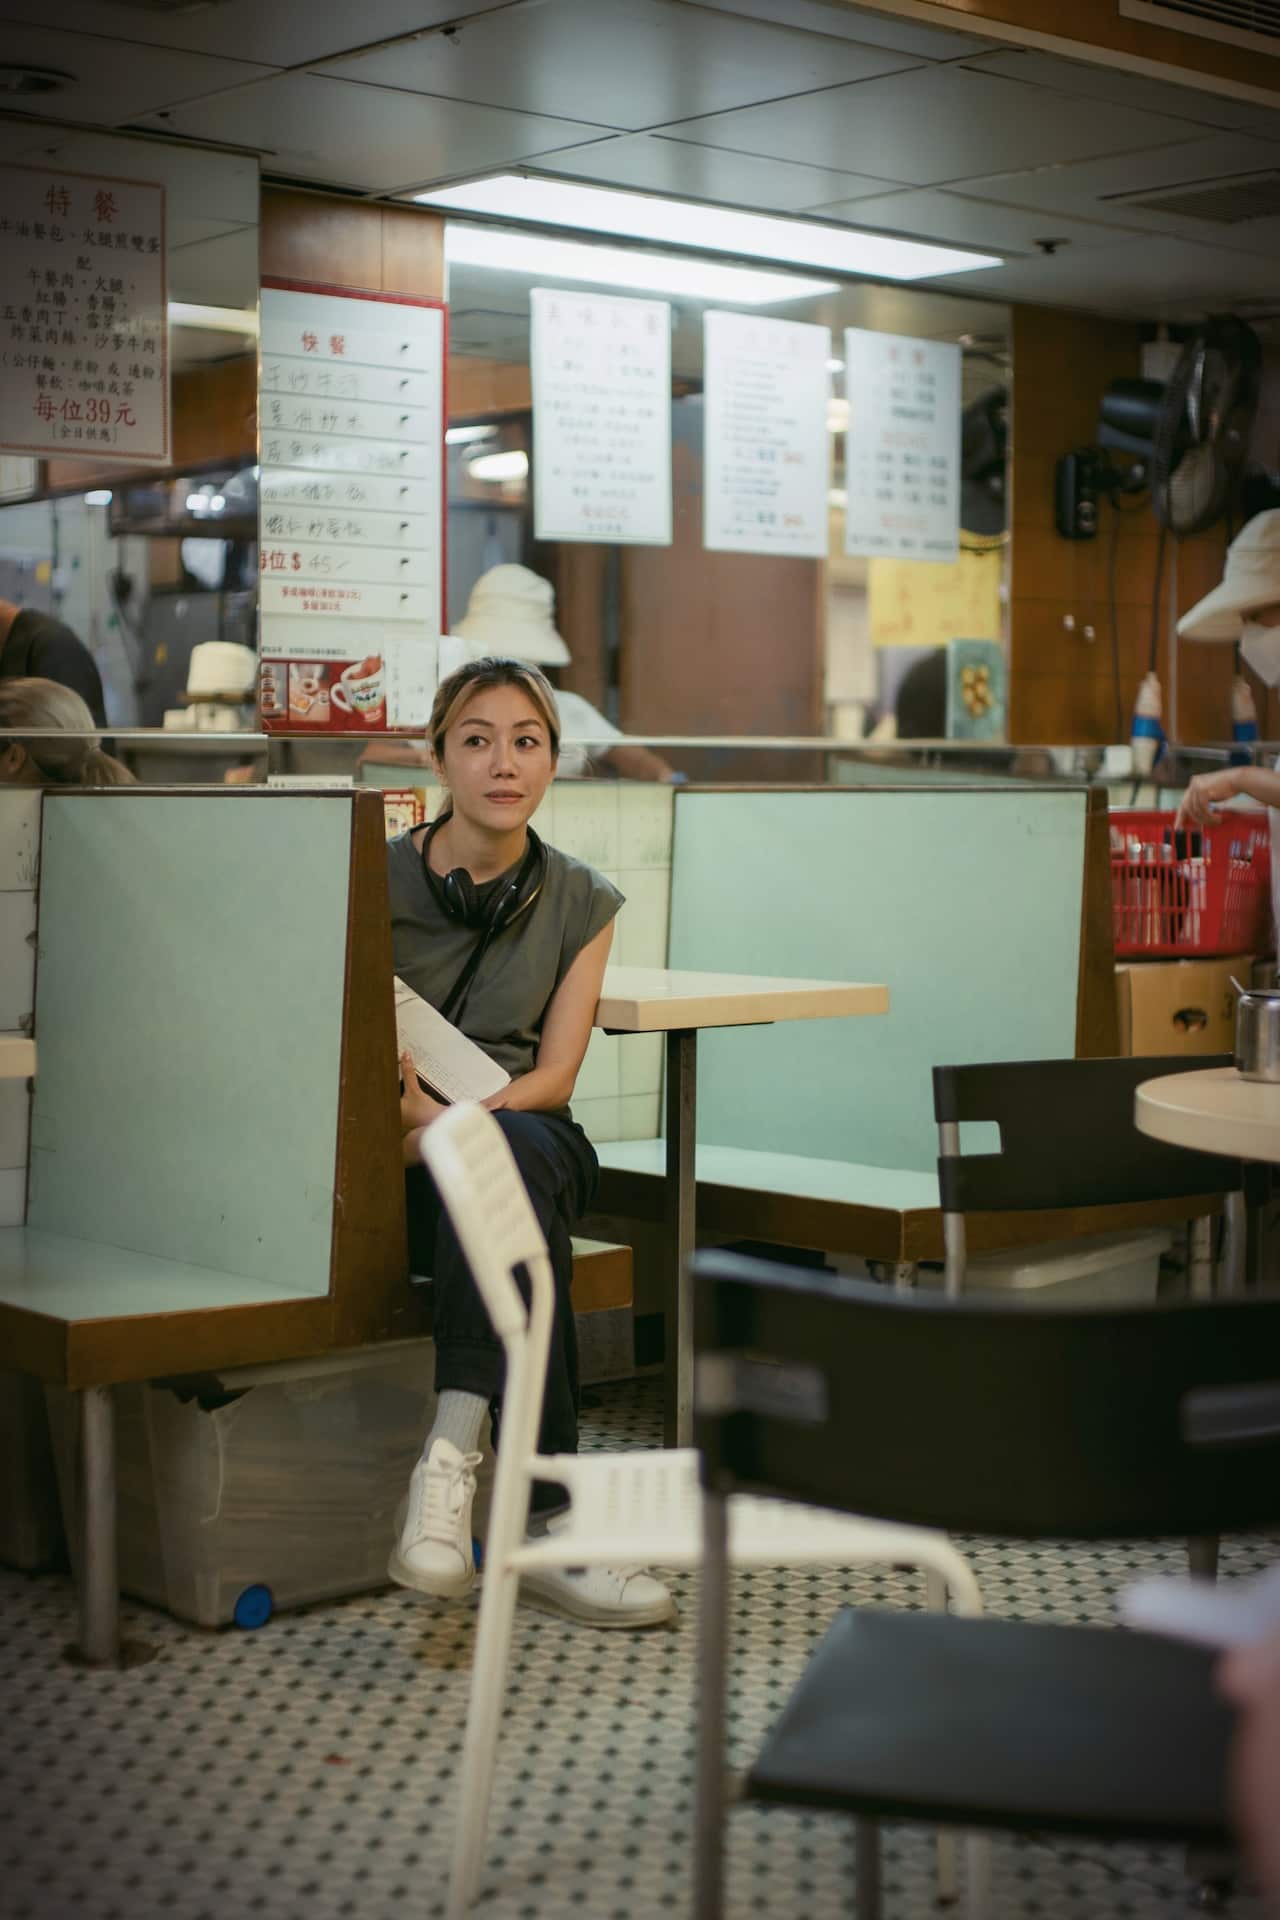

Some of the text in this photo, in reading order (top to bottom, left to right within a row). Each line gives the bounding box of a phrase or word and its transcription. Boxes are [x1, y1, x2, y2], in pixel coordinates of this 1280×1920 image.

[44, 184, 119, 223] 特餐
[33, 393, 136, 426] 每位39元
